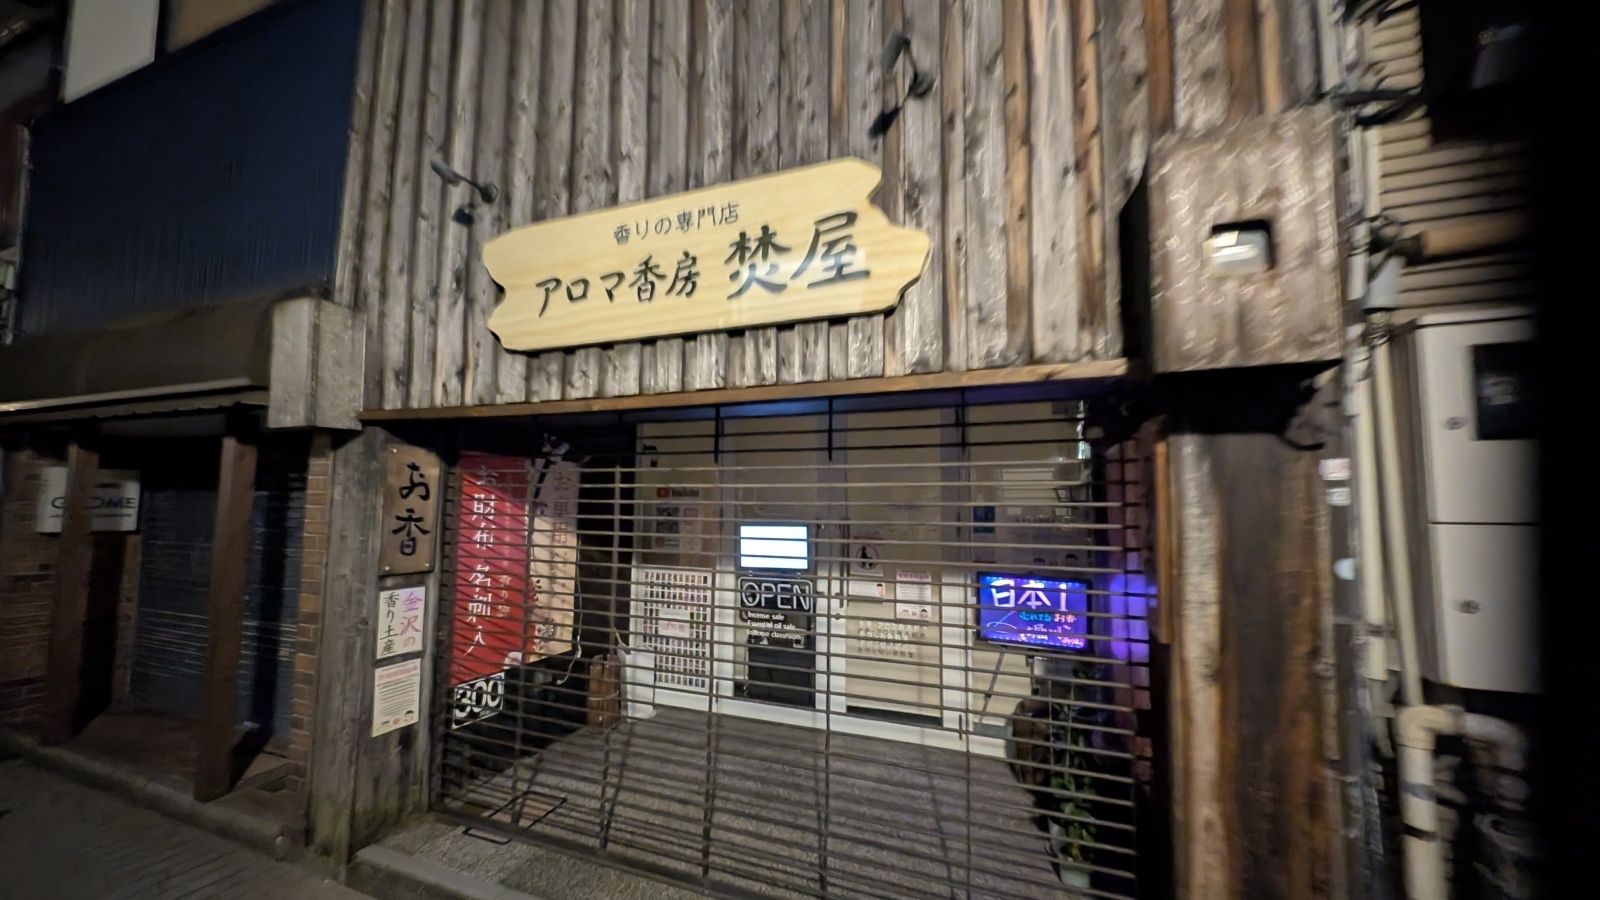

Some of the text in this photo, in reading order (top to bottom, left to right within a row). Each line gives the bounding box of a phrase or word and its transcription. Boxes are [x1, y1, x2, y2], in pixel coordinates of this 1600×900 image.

[612, 202, 740, 246] 香りの専門店
[535, 210, 871, 318] アロマ香房 焚屋
[392, 462, 432, 557] お香
[399, 591, 423, 648] 金沢の
[741, 581, 810, 611] OPEN
[747, 611, 785, 621] Incense sale
[379, 592, 400, 656] 香り土産
[455, 676, 502, 718] 300
